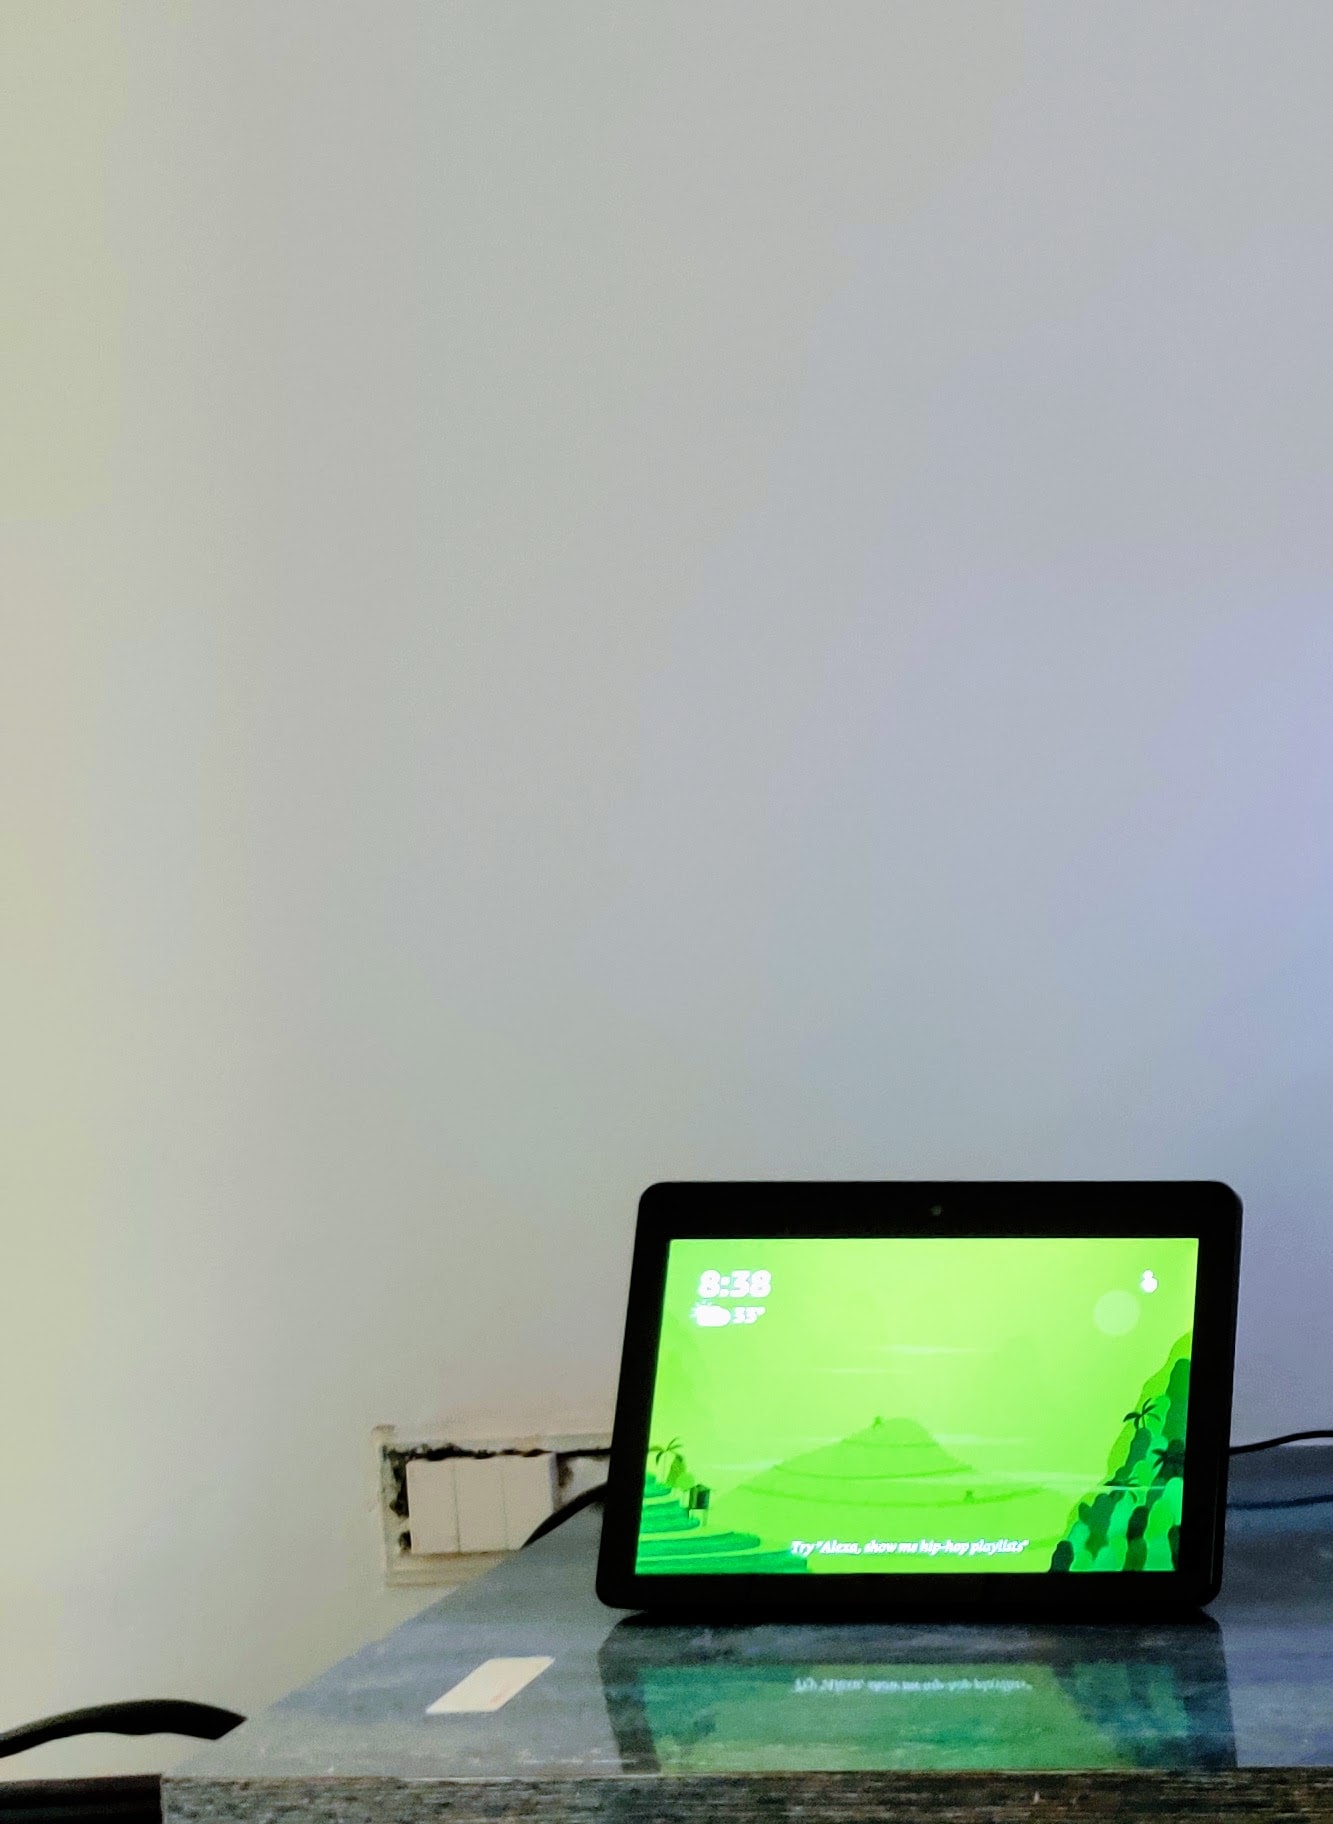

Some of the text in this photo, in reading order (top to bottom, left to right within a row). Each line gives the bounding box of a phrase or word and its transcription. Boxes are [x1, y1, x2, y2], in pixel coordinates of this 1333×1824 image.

[698, 1269, 771, 1298] 8:38
[791, 1540, 815, 1557] Try
[864, 1539, 897, 1553] show
[920, 1539, 969, 1556] hip-hop
